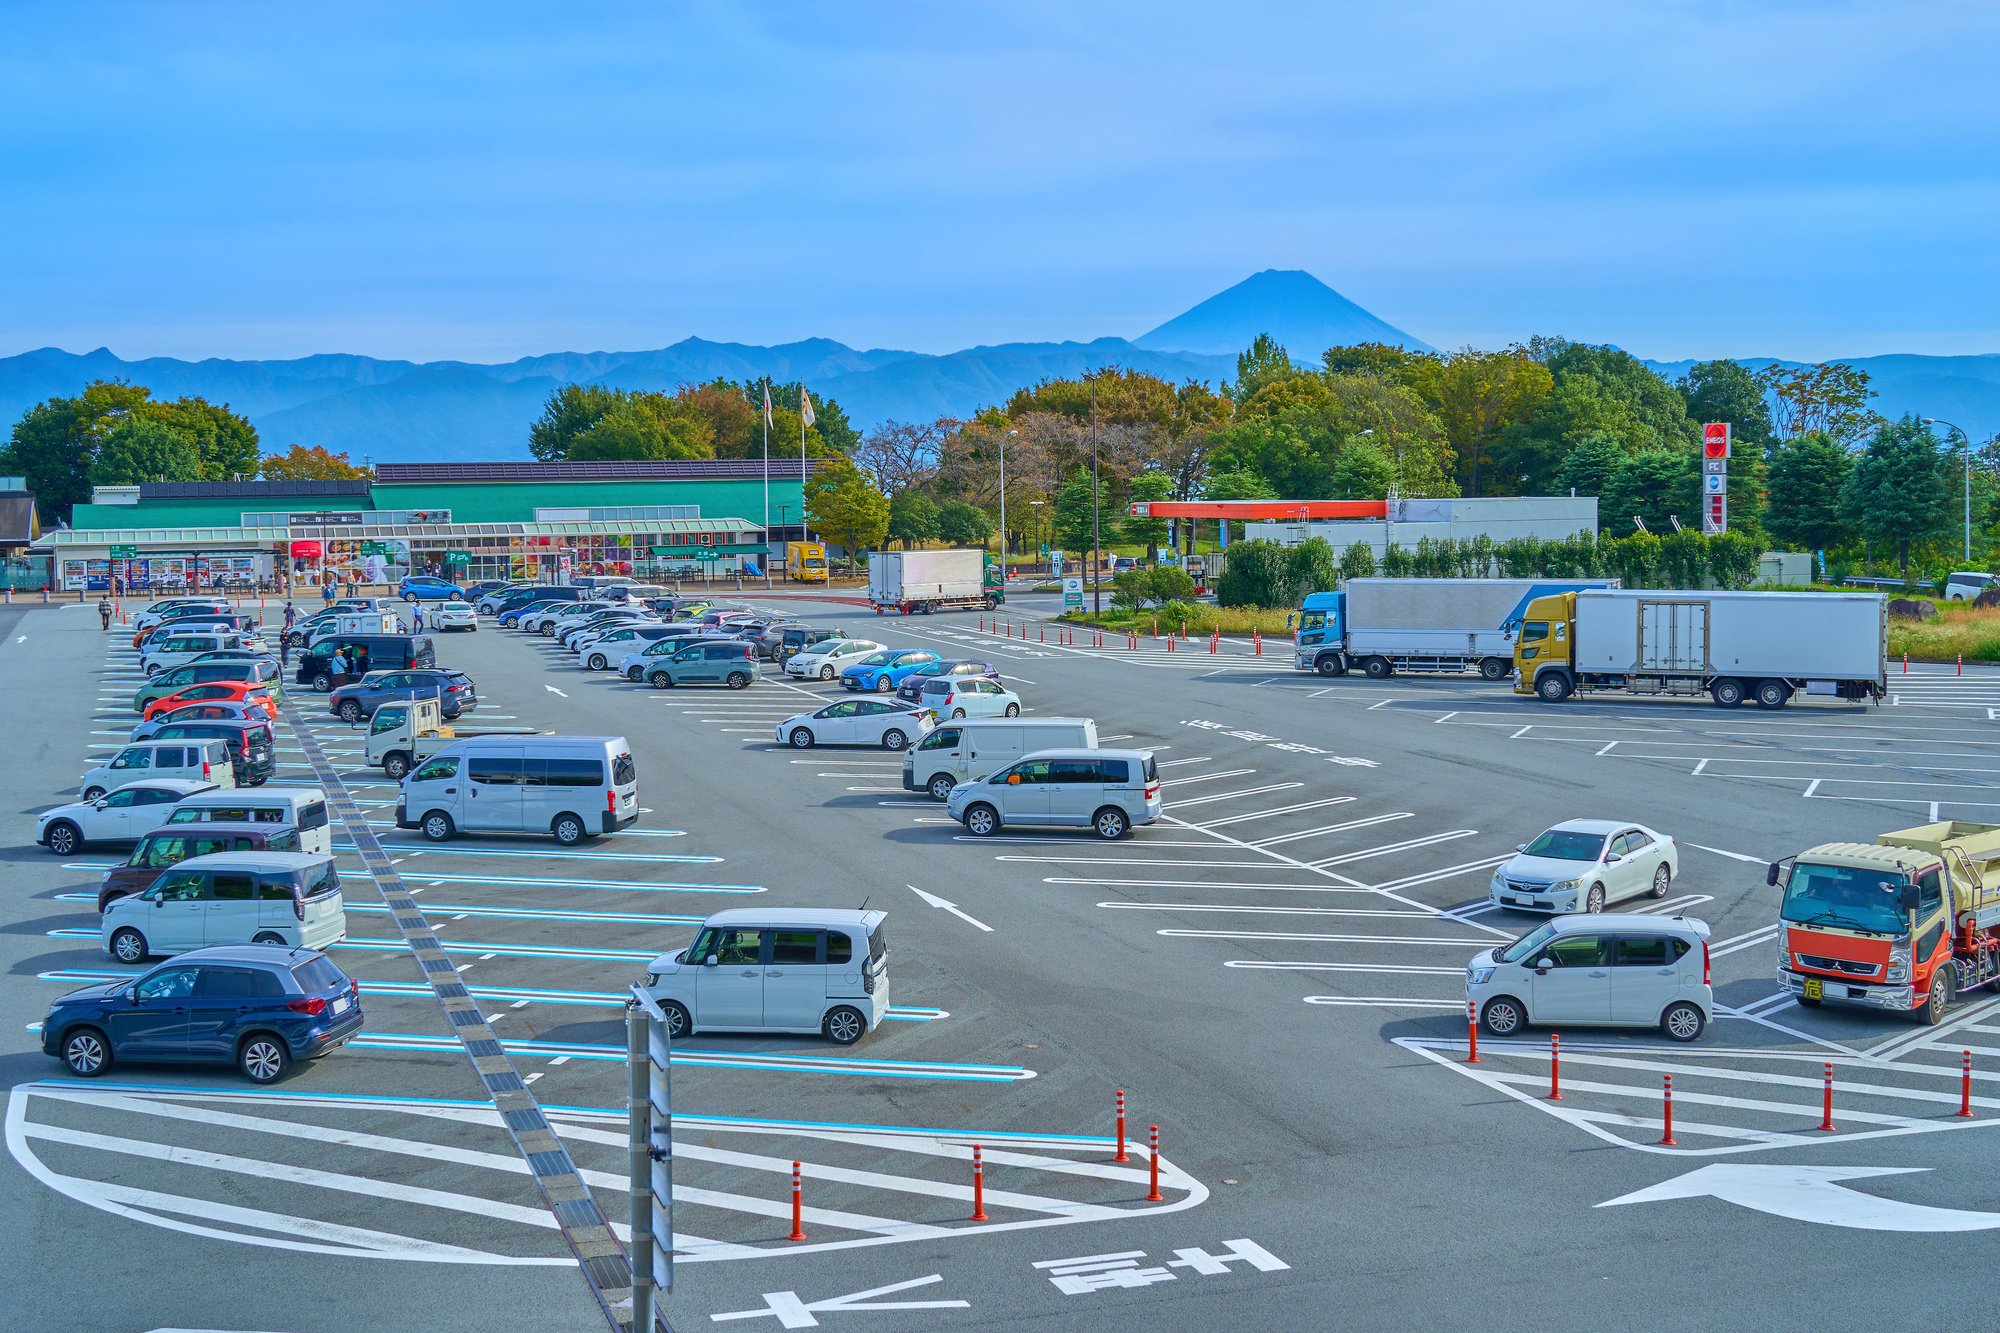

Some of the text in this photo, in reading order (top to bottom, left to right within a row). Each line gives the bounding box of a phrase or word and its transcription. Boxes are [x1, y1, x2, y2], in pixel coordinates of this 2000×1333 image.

[1706, 436, 1725, 444] ENEOS
[450, 553, 456, 561] P
[1805, 980, 1821, 998] 危
